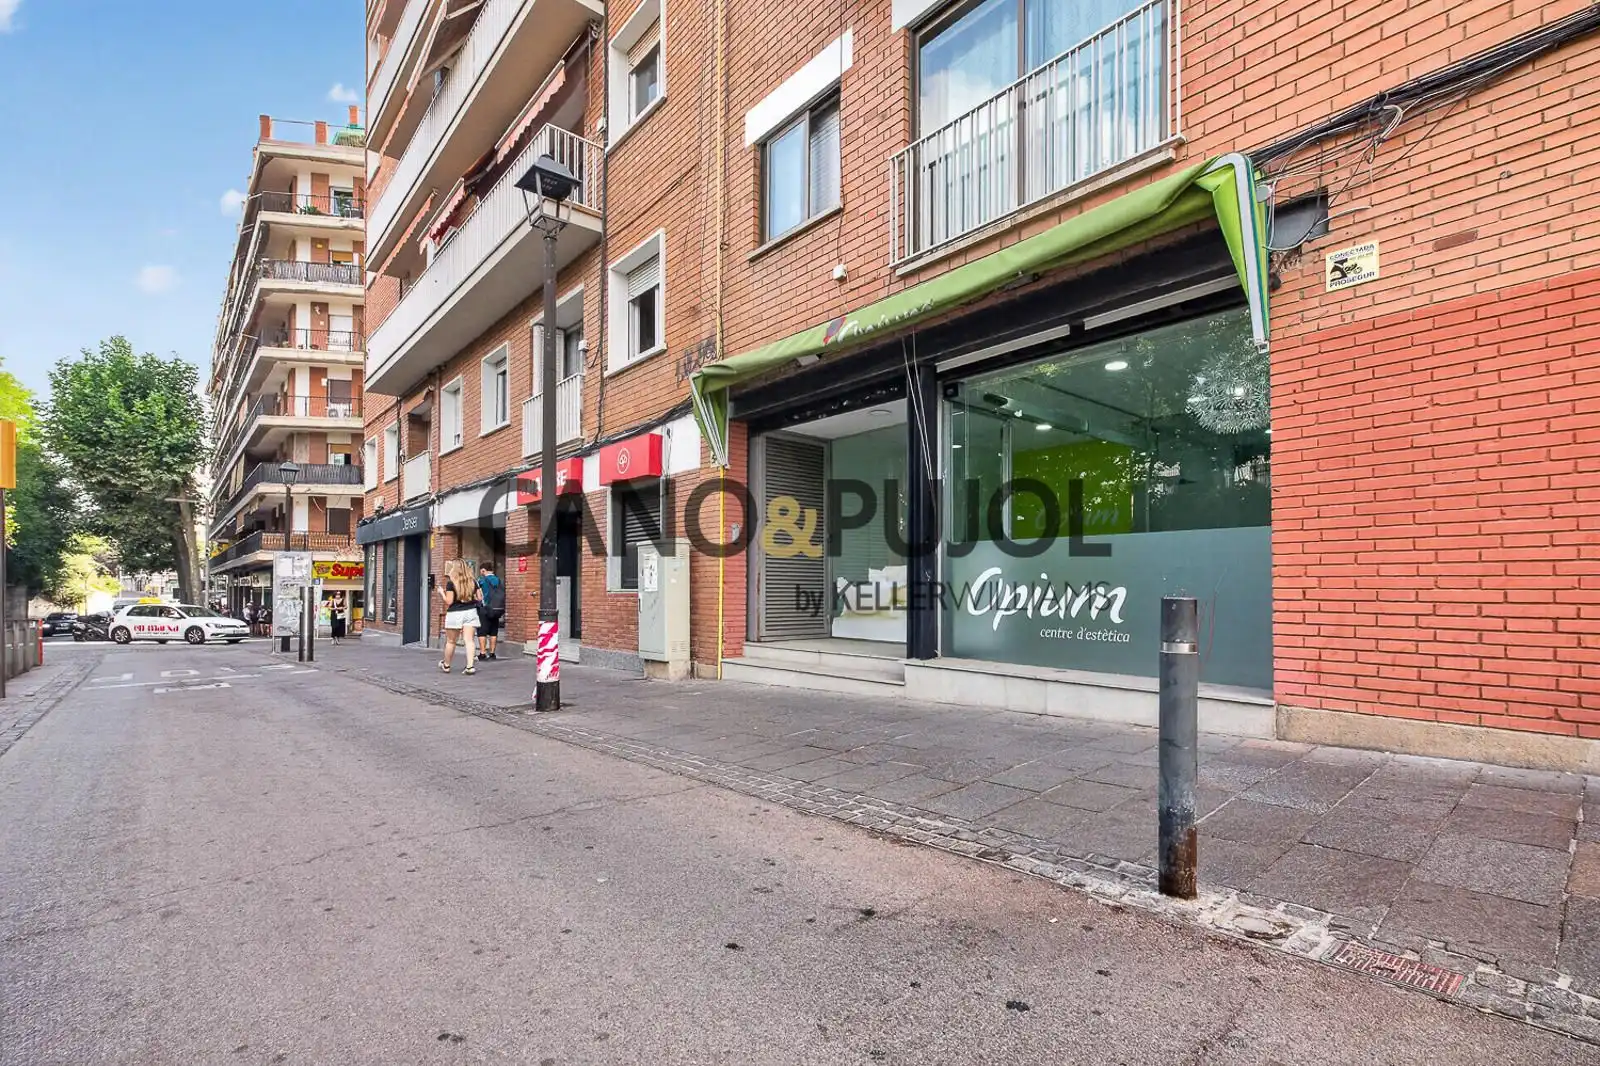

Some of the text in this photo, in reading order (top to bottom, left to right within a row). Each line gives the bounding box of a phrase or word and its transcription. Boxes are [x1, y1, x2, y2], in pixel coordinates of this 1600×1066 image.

[967, 567, 1127, 631] Opium
[1040, 627, 1130, 642] centre d'estètica
